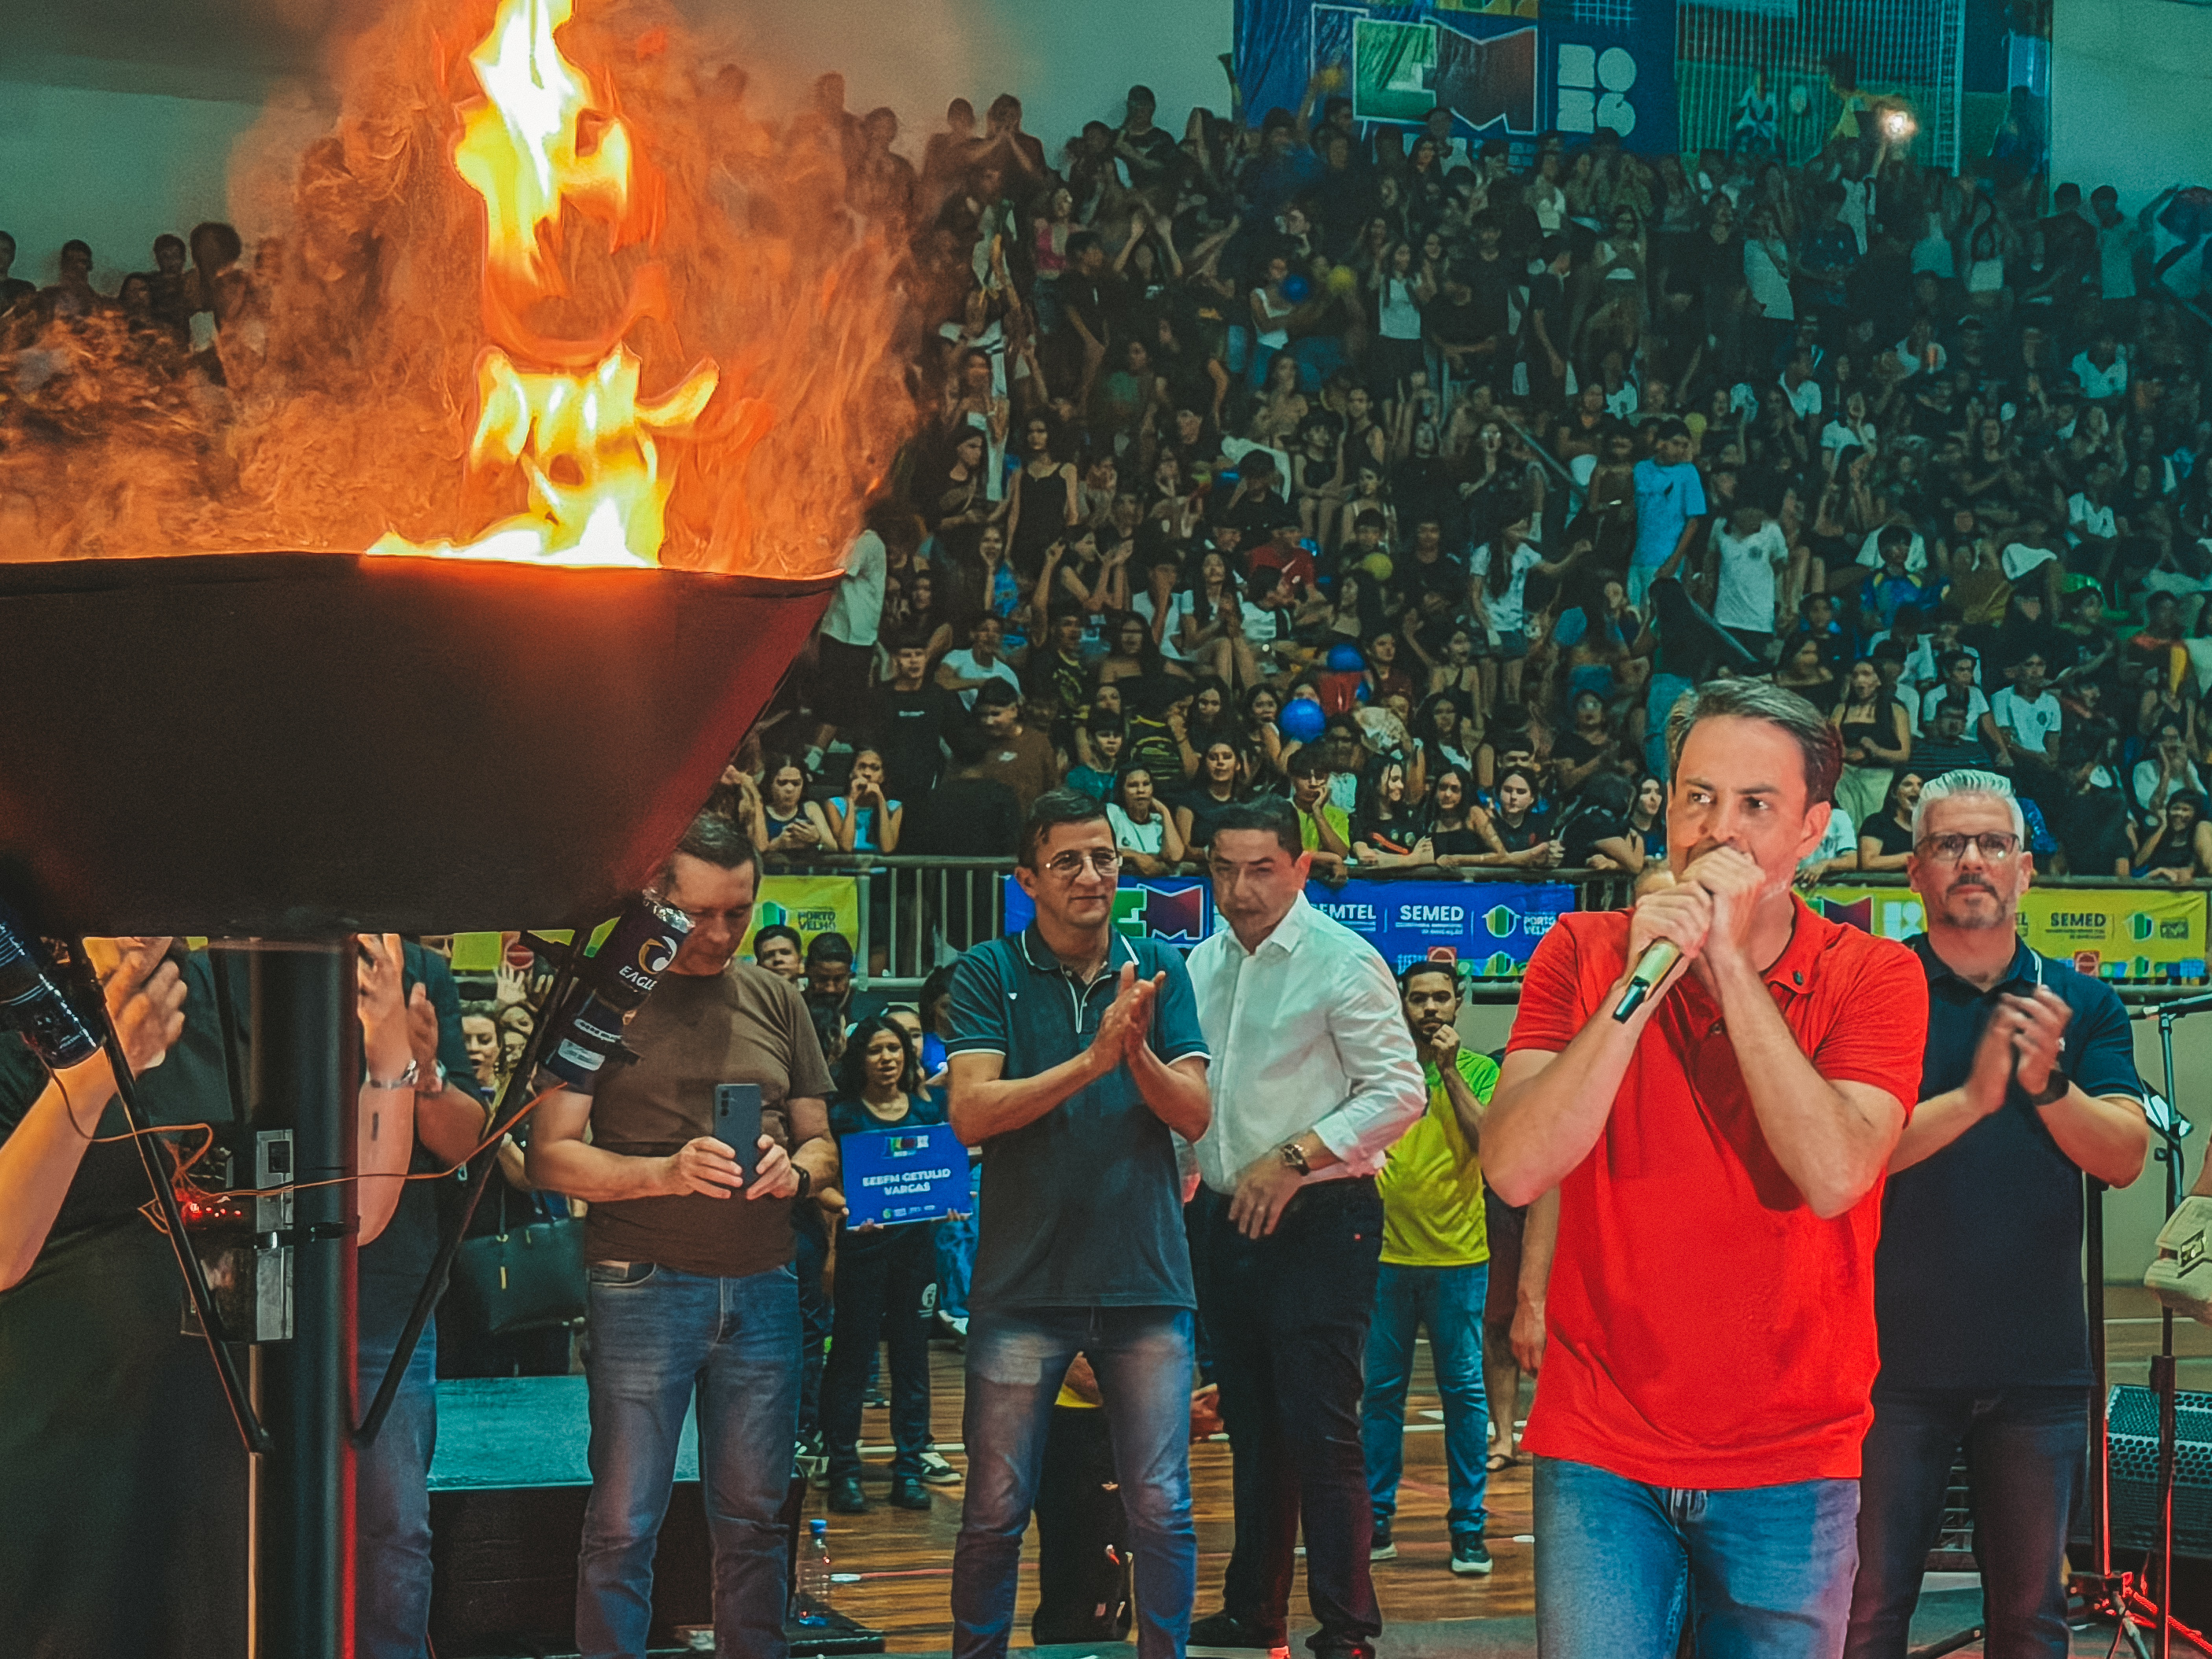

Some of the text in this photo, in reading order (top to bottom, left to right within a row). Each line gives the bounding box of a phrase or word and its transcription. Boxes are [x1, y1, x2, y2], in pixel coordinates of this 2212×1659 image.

[1309, 903, 1377, 920] EMTEL
[1399, 905, 1464, 921] SEMED
[2050, 912, 2107, 927] SEMED
[883, 1182, 931, 1196] VARGAS
